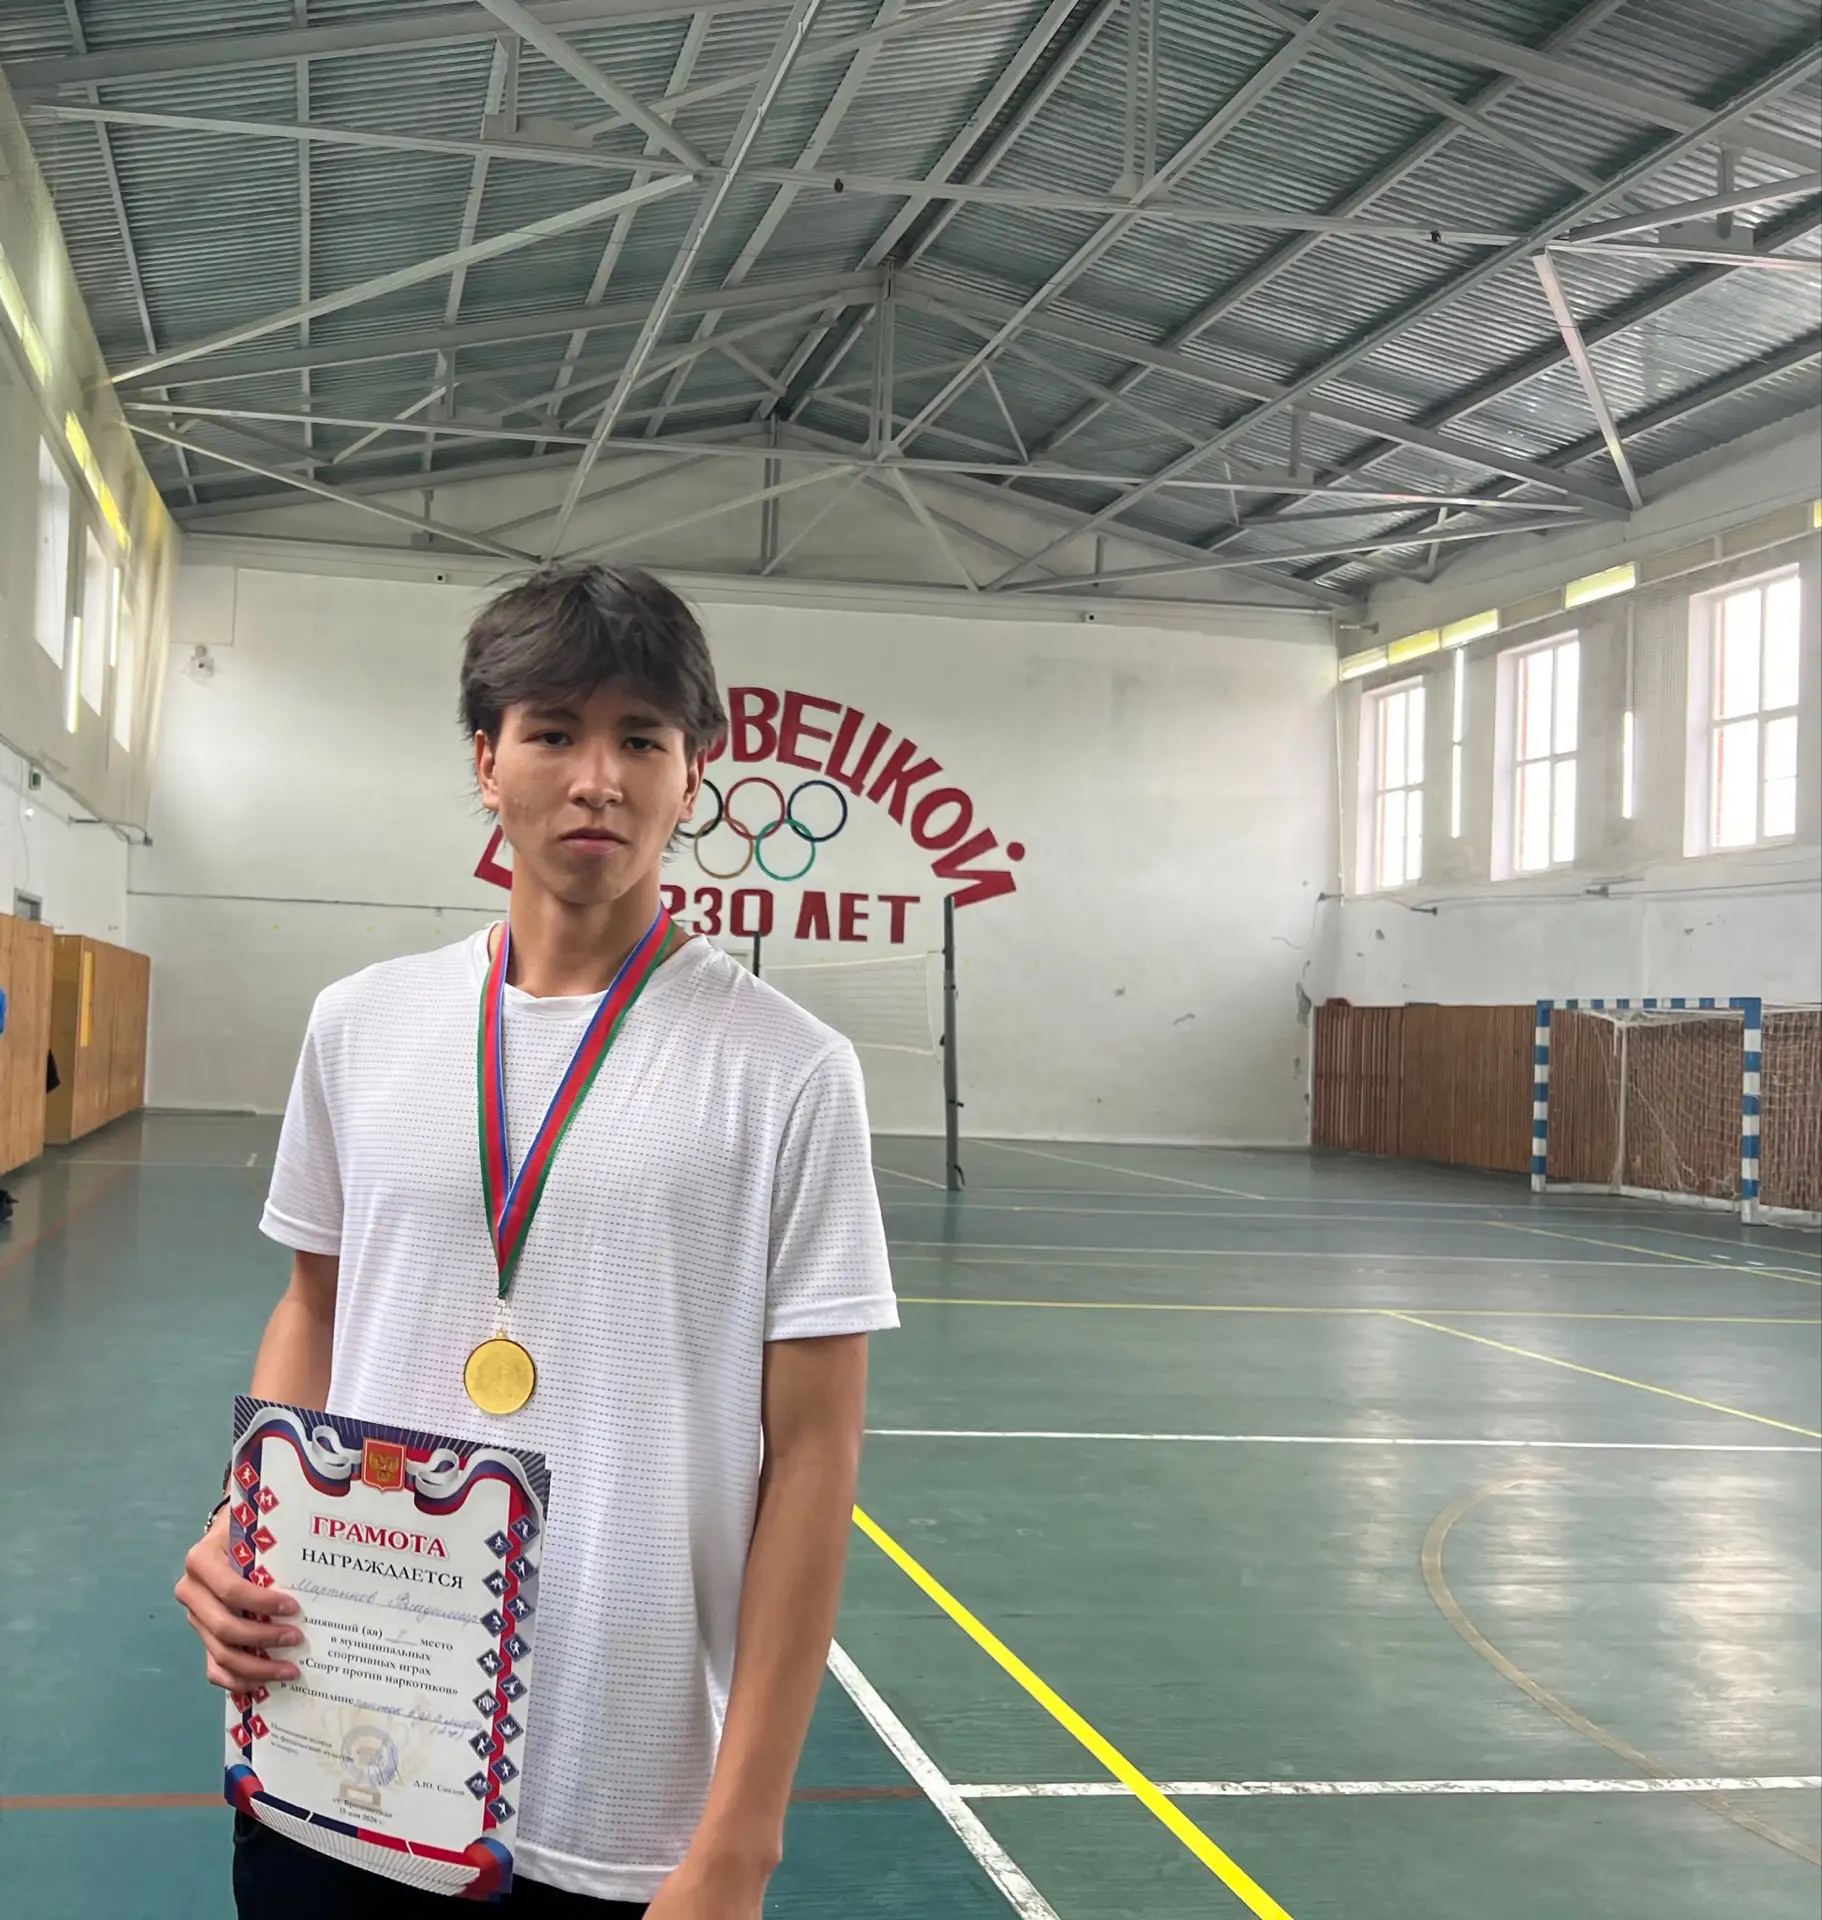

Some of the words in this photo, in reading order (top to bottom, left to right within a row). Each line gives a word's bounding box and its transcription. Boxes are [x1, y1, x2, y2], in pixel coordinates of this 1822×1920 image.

[795, 891, 920, 944] ЛЕТ
[312, 1516, 447, 1558] ГРАМОТА
[300, 1547, 464, 1590] НАГРАЖДАЕТСЯ
[339, 1637, 432, 1662] муниципальных
[420, 1637, 454, 1652] место
[327, 1649, 397, 1670] спортивных
[399, 1663, 432, 1677] играх
[342, 1667, 383, 1682] против
